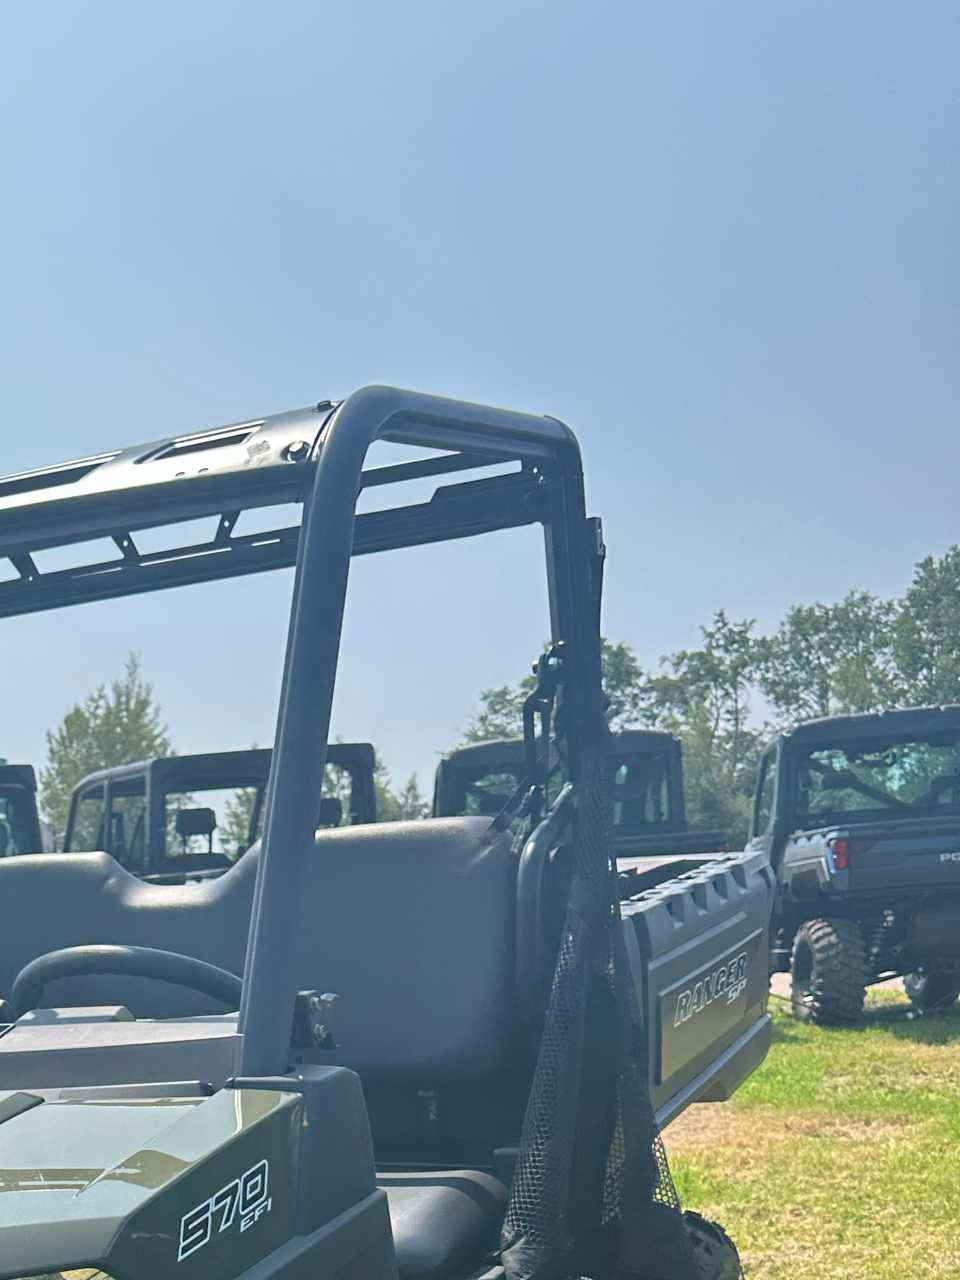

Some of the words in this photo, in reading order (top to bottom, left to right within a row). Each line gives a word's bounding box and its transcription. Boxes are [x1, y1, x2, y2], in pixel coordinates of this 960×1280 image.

[673, 951, 747, 1028] RANGER
[726, 978, 748, 1005] SP
[177, 1159, 269, 1262] 570
[240, 1197, 272, 1233] EFI
